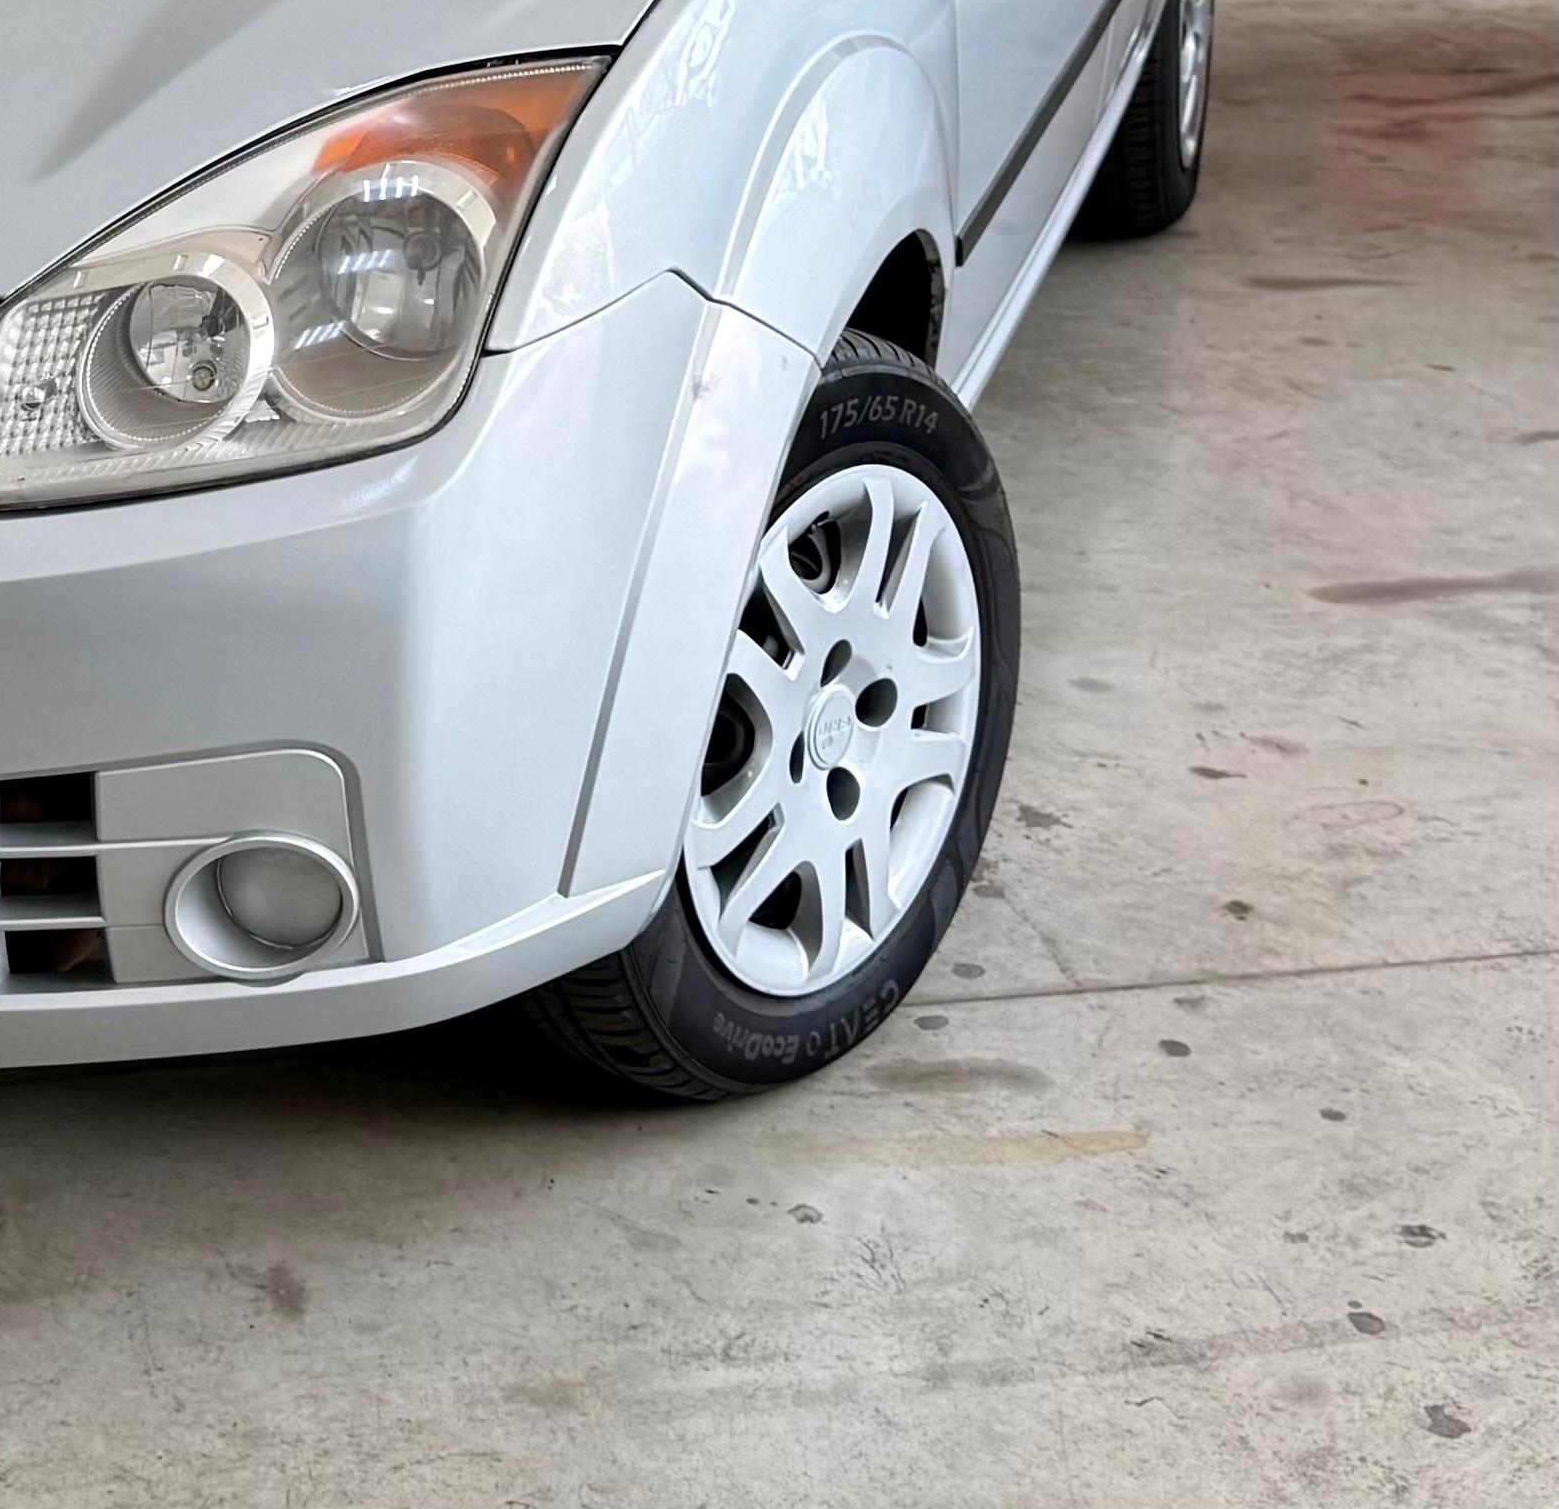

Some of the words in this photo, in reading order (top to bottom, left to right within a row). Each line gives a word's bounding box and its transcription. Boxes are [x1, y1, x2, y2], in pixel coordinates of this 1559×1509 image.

[820, 394, 899, 440] 175/65
[900, 397, 939, 434] R14
[712, 1011, 800, 1065] EcoDrive
